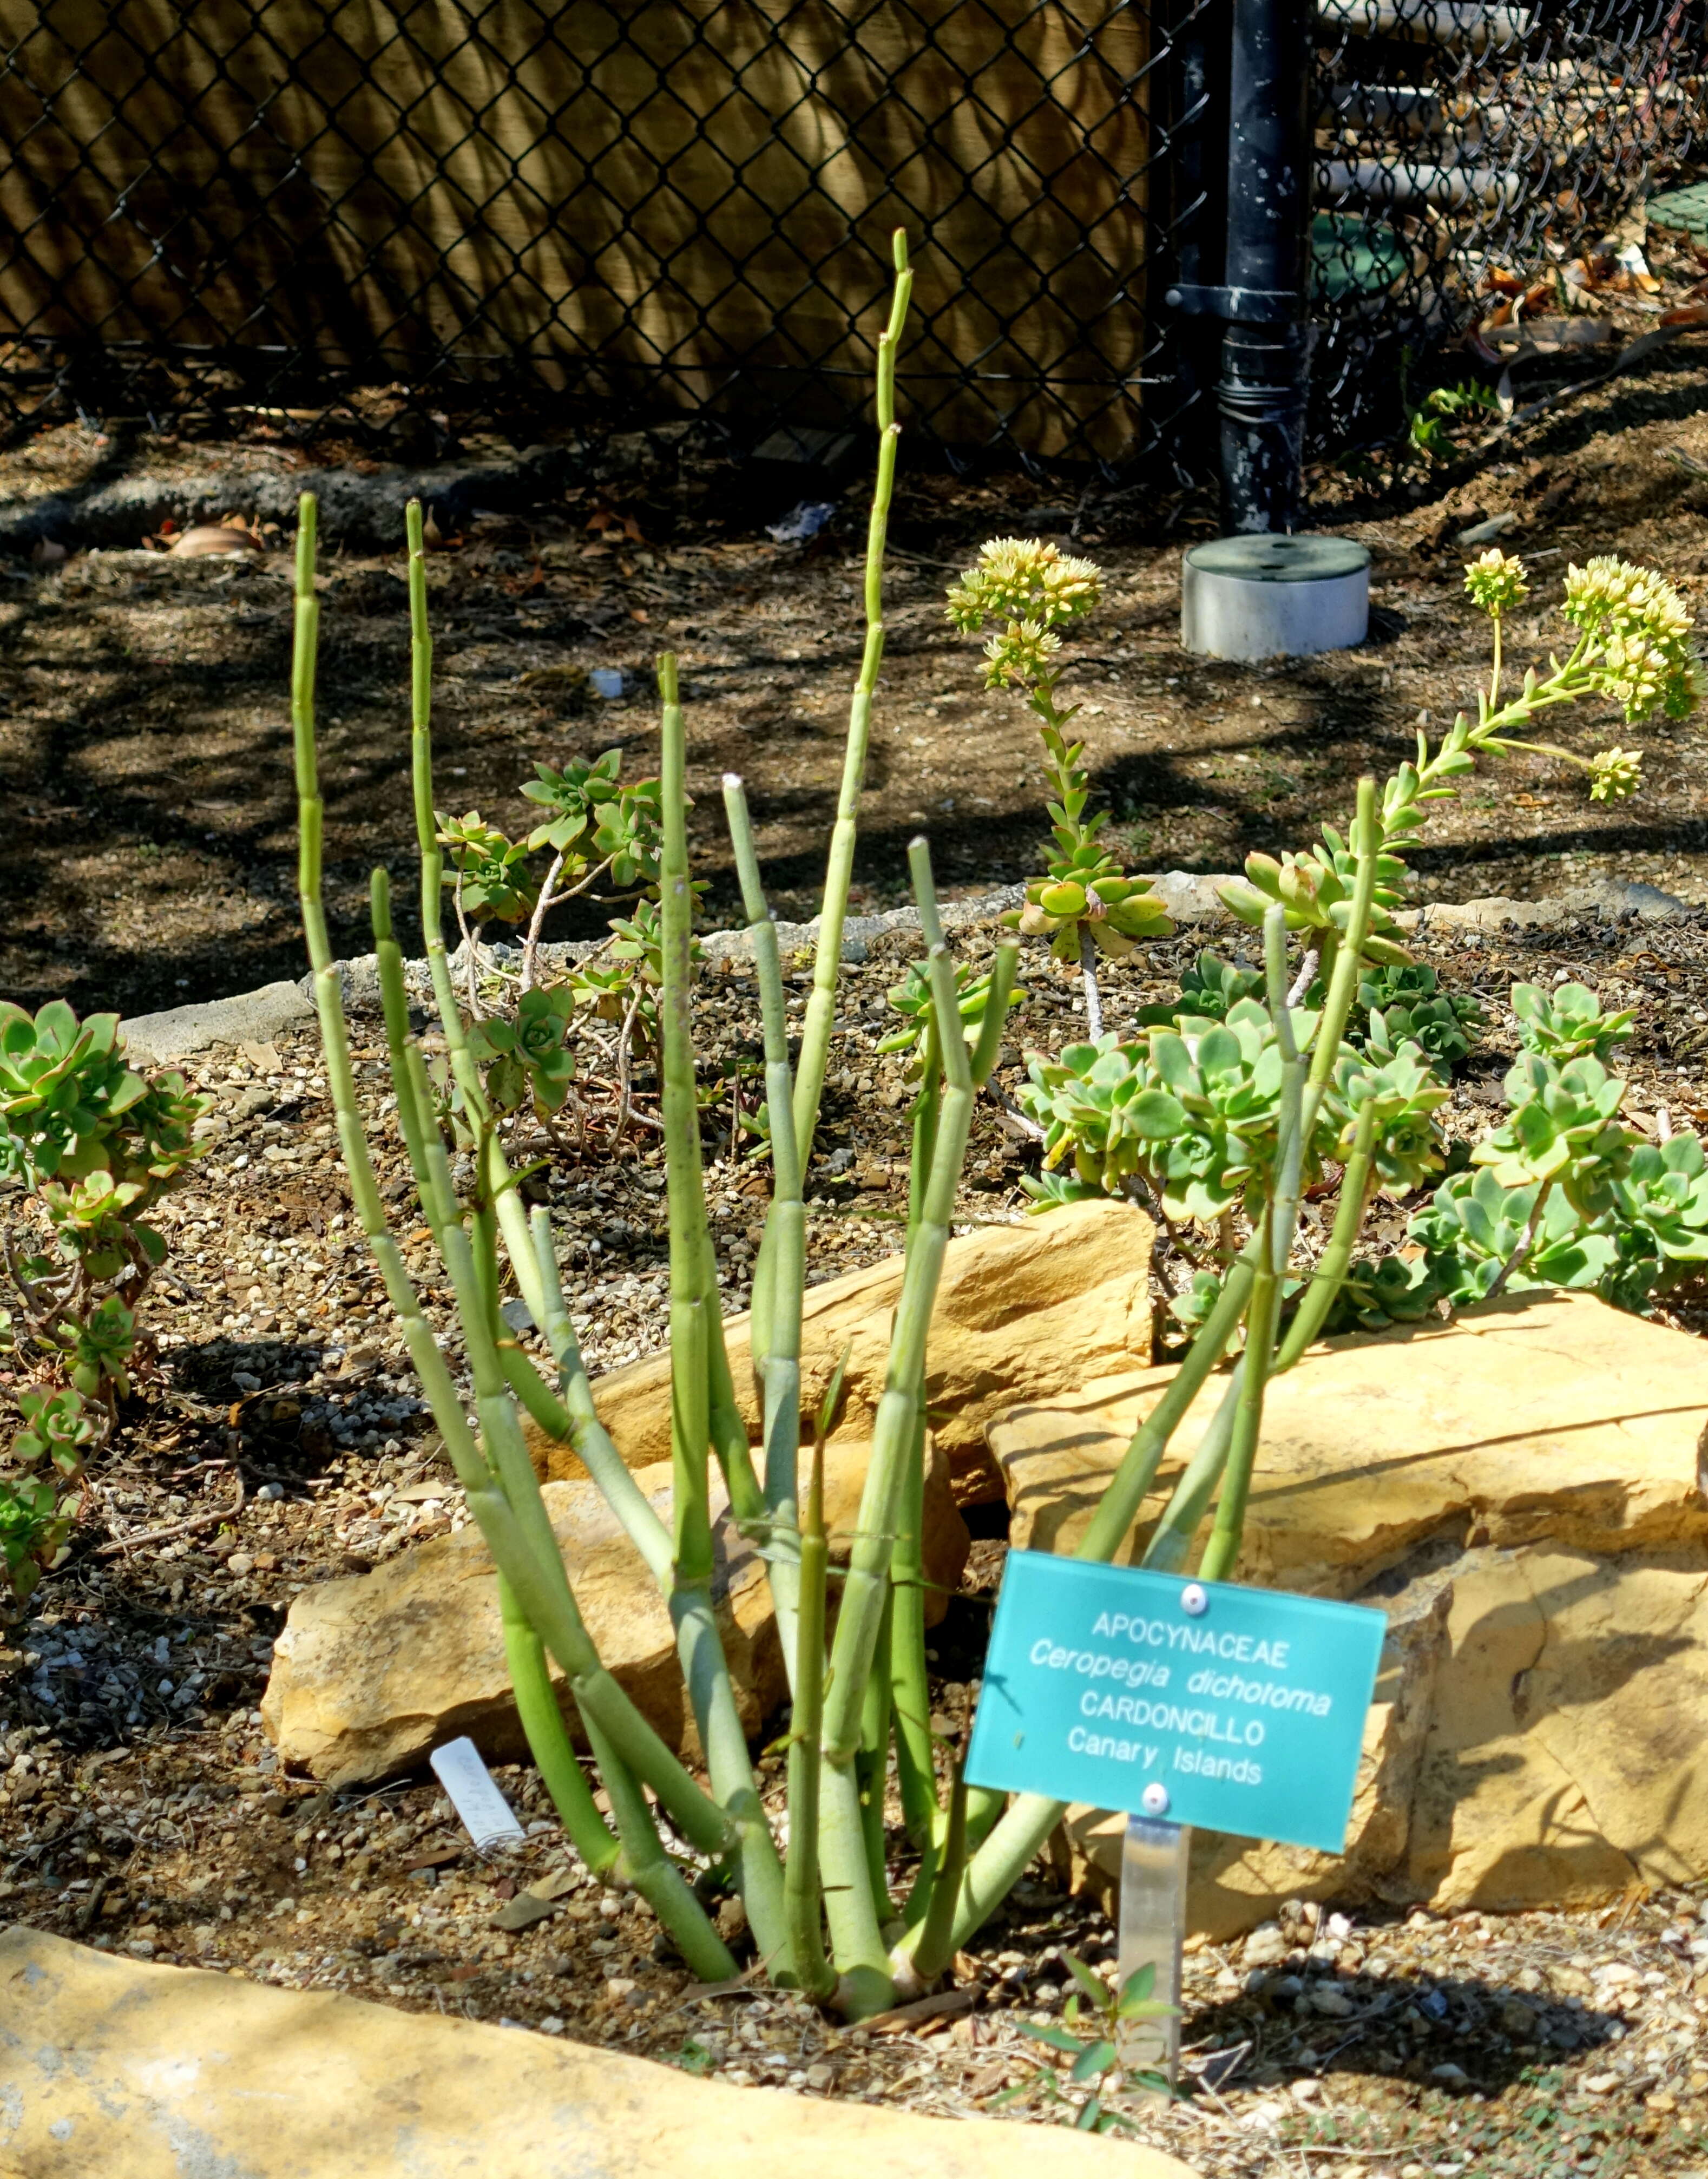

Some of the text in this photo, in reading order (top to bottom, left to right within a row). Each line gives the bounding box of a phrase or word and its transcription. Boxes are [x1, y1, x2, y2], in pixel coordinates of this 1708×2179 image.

[1091, 1611, 1290, 1669] APOCYNACEAE
[1029, 1637, 1332, 1716] Ceropegia dichotoma
[1080, 1690, 1265, 1747] CARDONCILLO
[1067, 1725, 1262, 1785] Canary Islands
